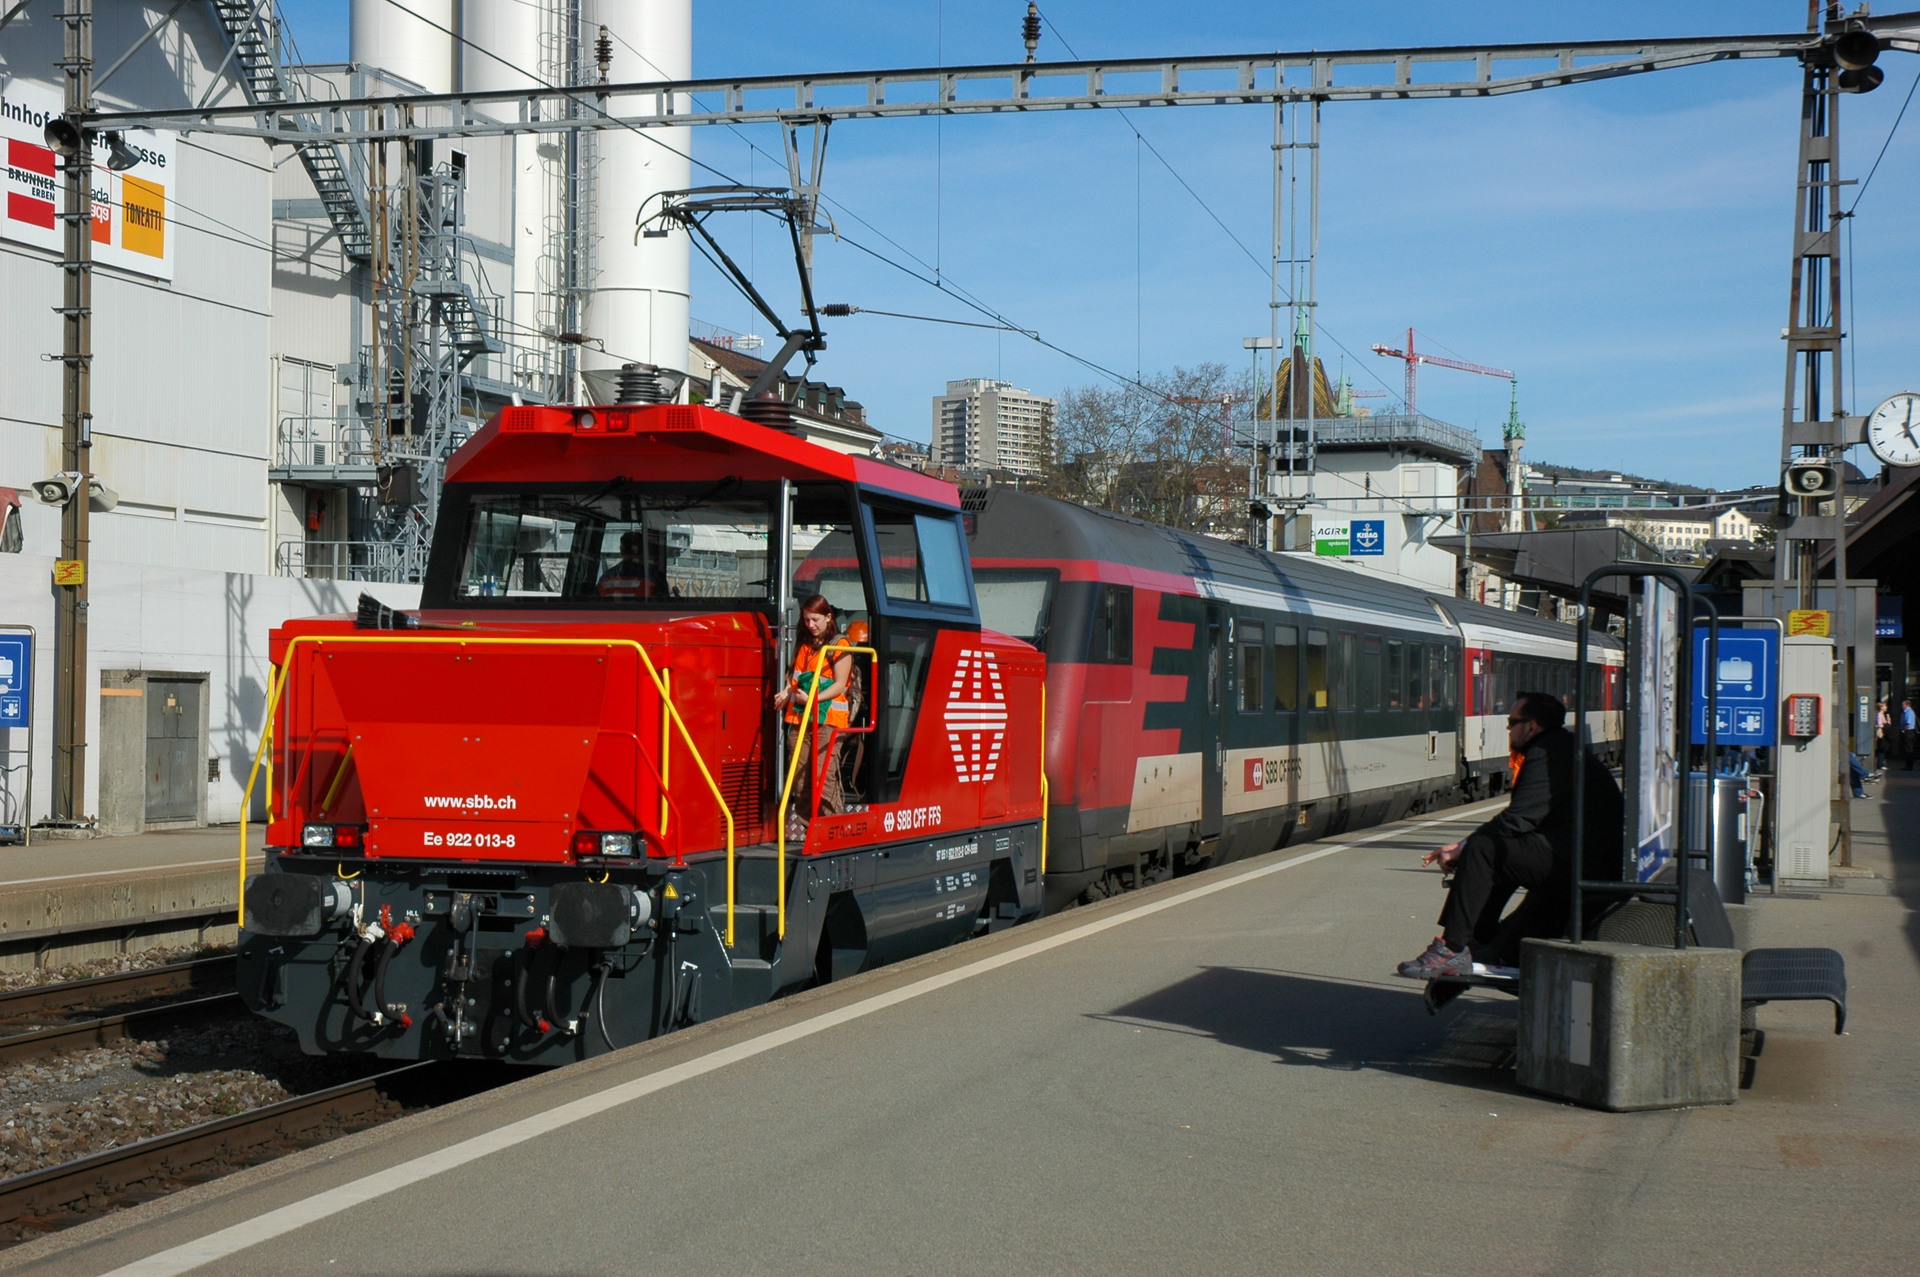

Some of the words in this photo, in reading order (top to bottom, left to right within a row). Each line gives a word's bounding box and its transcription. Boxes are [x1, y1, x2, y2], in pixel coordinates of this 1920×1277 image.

[8, 168, 55, 191] BRUNNER
[32, 187, 55, 201] ERBEN
[91, 187, 109, 205] ada
[125, 201, 162, 232] TONEATTI
[1317, 527, 1341, 536] AGIR
[1228, 617, 1234, 643] 2
[1265, 760, 1278, 784] SBB
[424, 795, 517, 809] www.sbb.ch
[897, 809, 912, 831] SBB
[913, 807, 927, 829] CFF
[928, 805, 942, 826] FFS
[424, 832, 443, 846] Ee
[446, 833, 472, 847] 922
[475, 834, 516, 848] 013-8
